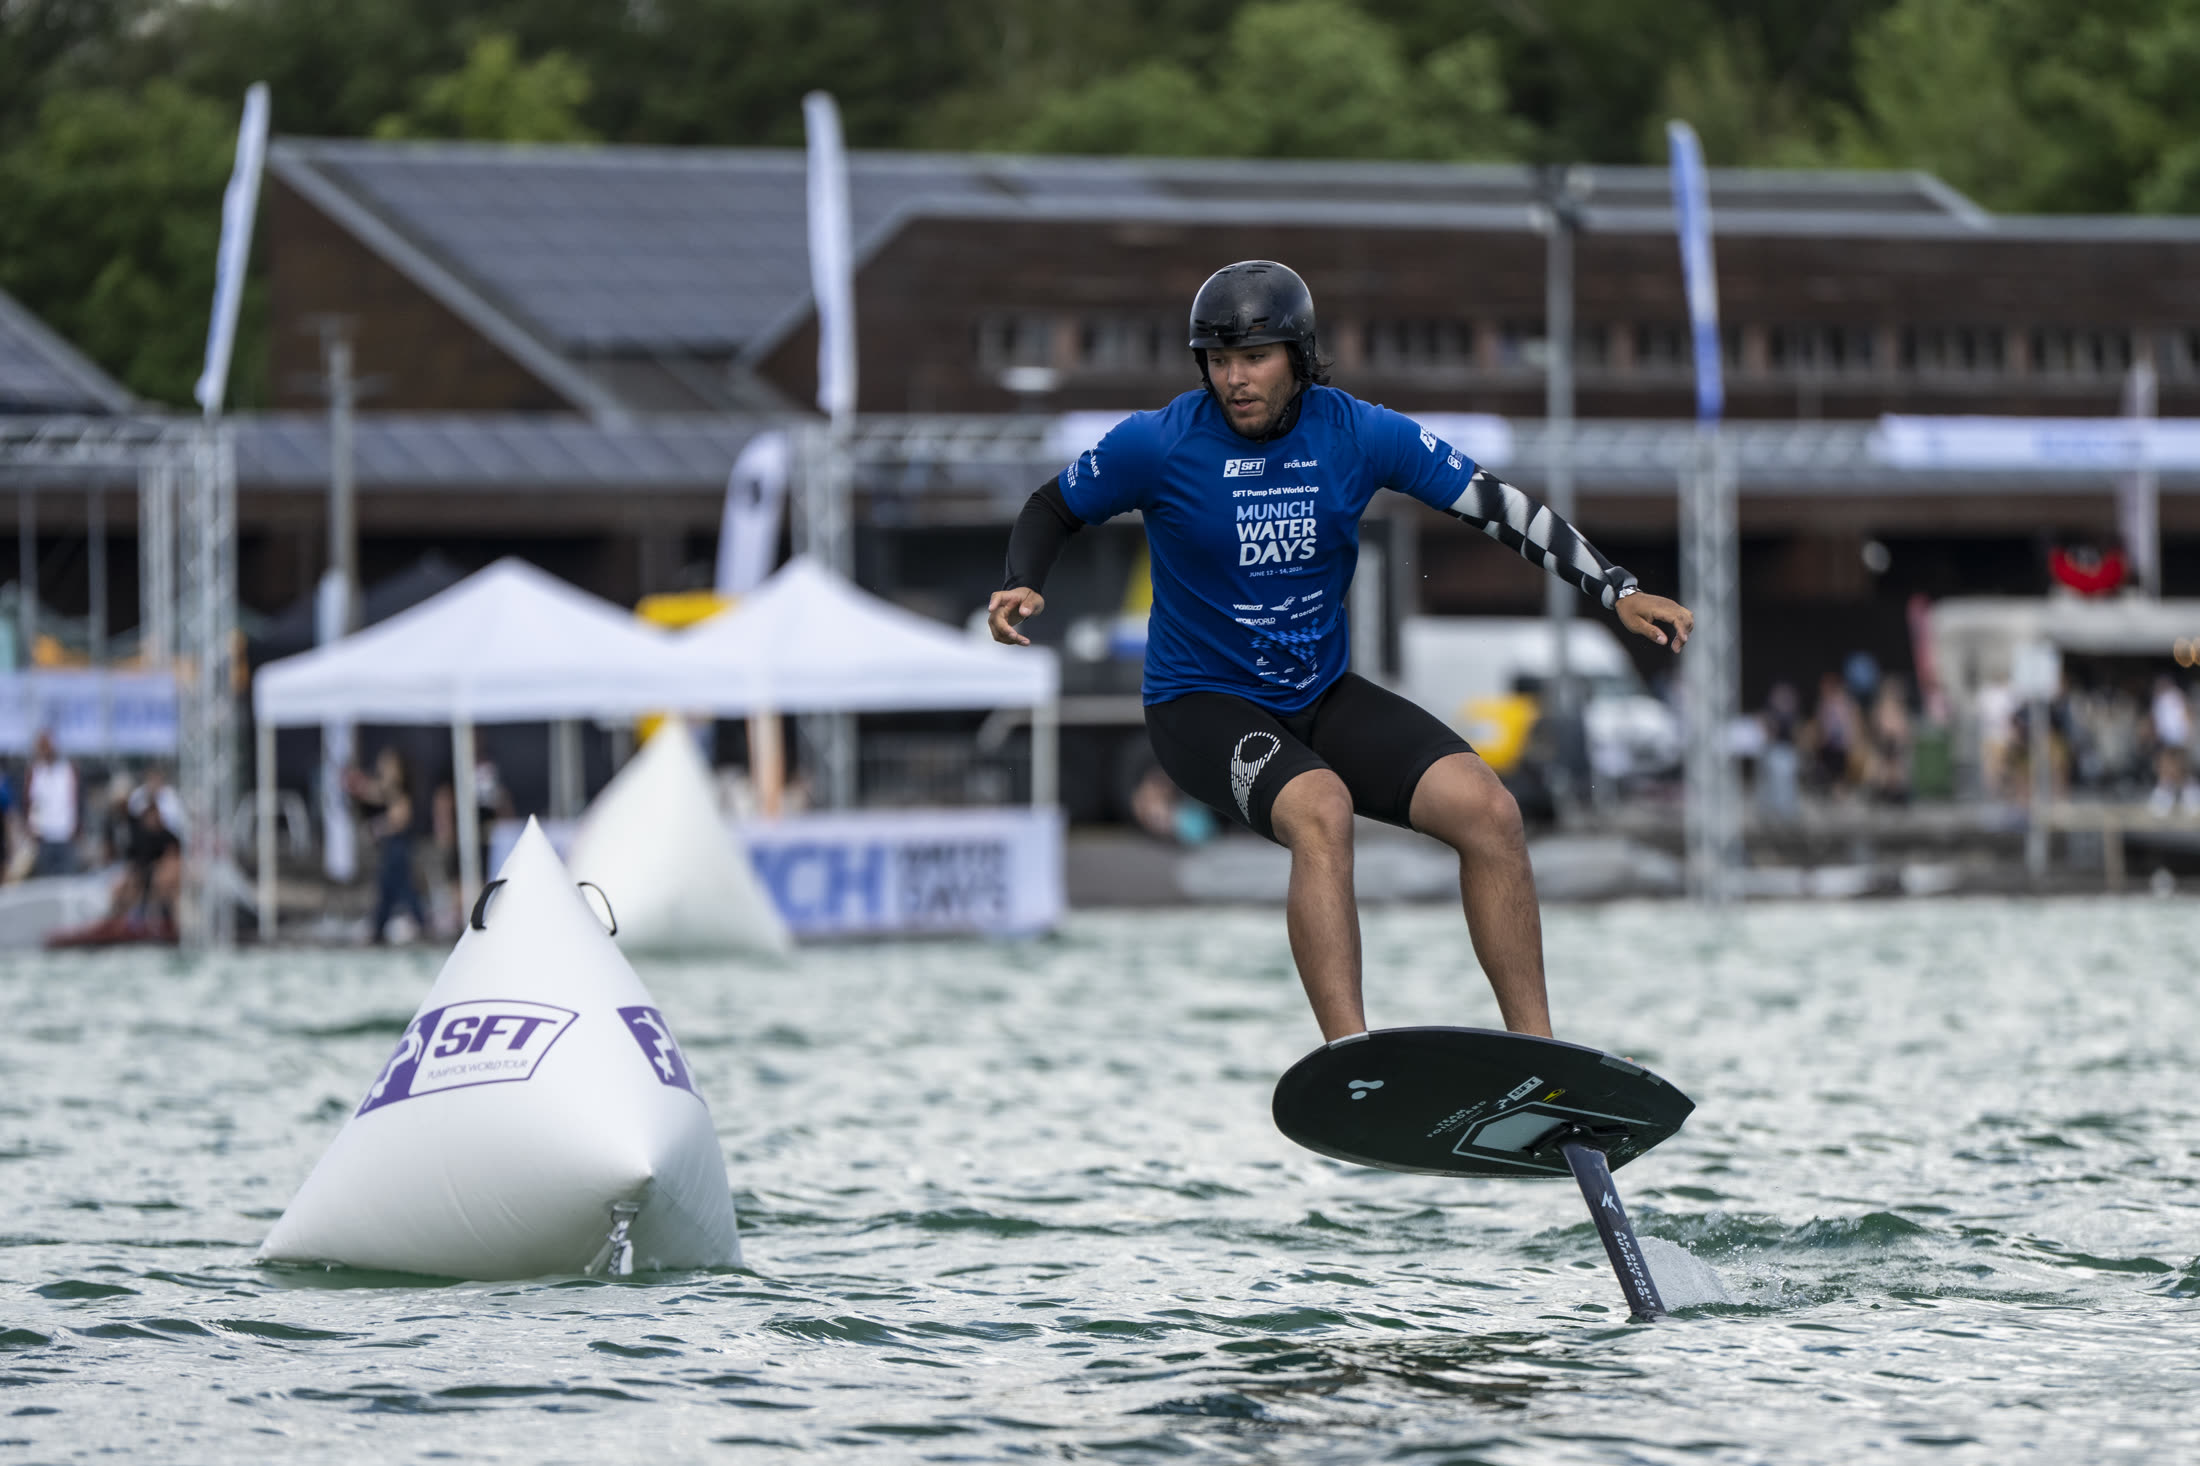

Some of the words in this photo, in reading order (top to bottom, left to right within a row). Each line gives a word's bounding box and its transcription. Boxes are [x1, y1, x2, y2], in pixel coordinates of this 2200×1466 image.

[1240, 461, 1263, 471] SFT
[1301, 460, 1318, 468] BASE
[1232, 490, 1246, 498] SFT
[1247, 489, 1268, 497] Pump
[1268, 487, 1282, 496] Foil
[1282, 486, 1304, 494] World
[1304, 485, 1320, 494] Cup
[1236, 500, 1315, 522] MUNICH
[1236, 518, 1317, 542] WATER
[1239, 538, 1317, 566] DAYS
[433, 1015, 558, 1058] SFT
[468, 1060, 502, 1073] WORLD
[503, 1059, 528, 1069] TOUR
[1511, 1079, 1536, 1097] SFT
[1613, 1230, 1637, 1275] SUPPLY
[1634, 1279, 1645, 1300] CO.
[1620, 1231, 1632, 1249] AK
[1629, 1253, 1656, 1308] DURABLE
